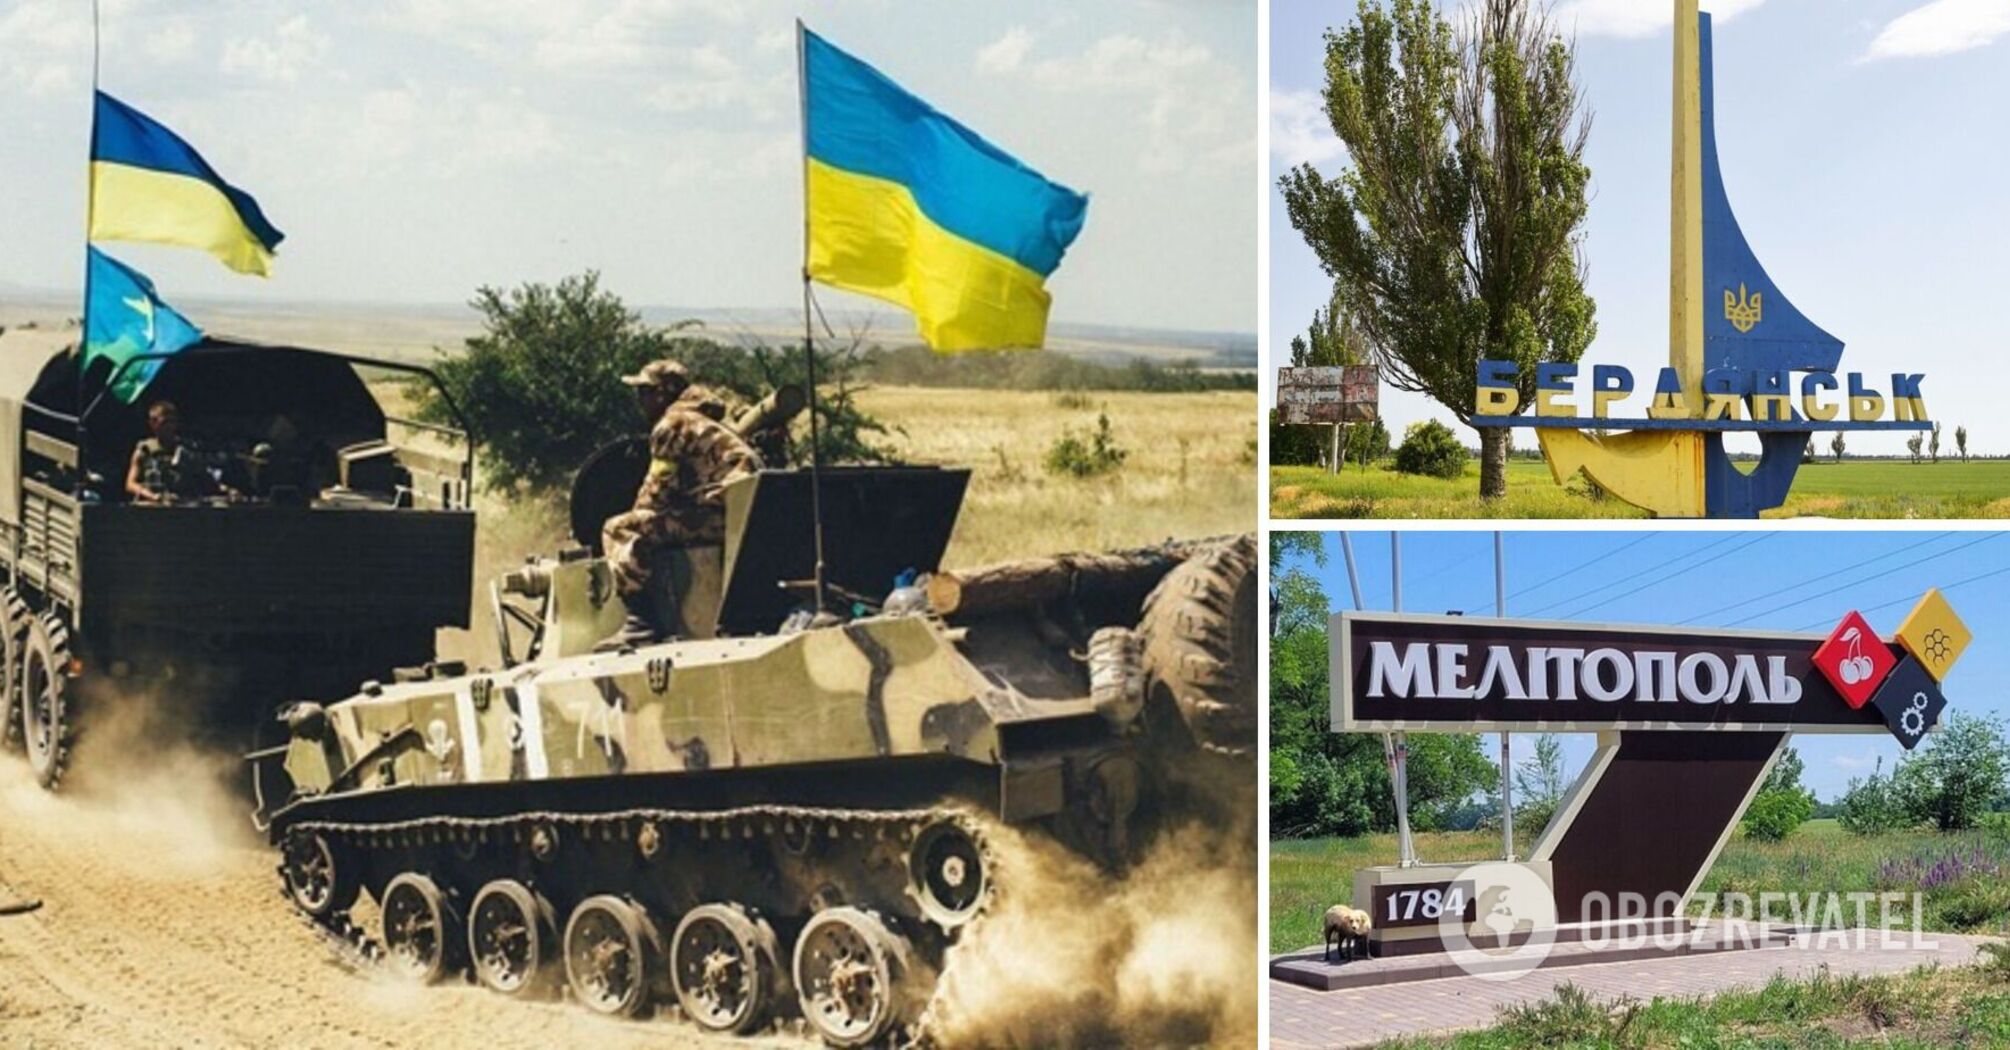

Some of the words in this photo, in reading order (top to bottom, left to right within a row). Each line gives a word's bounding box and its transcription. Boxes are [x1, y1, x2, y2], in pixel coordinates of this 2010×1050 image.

[1476, 359, 1928, 421] БЕРДЯНСЬК
[1366, 641, 1803, 704] МЕЛІТОПОЛЬ
[1386, 887, 1466, 921] 1784
